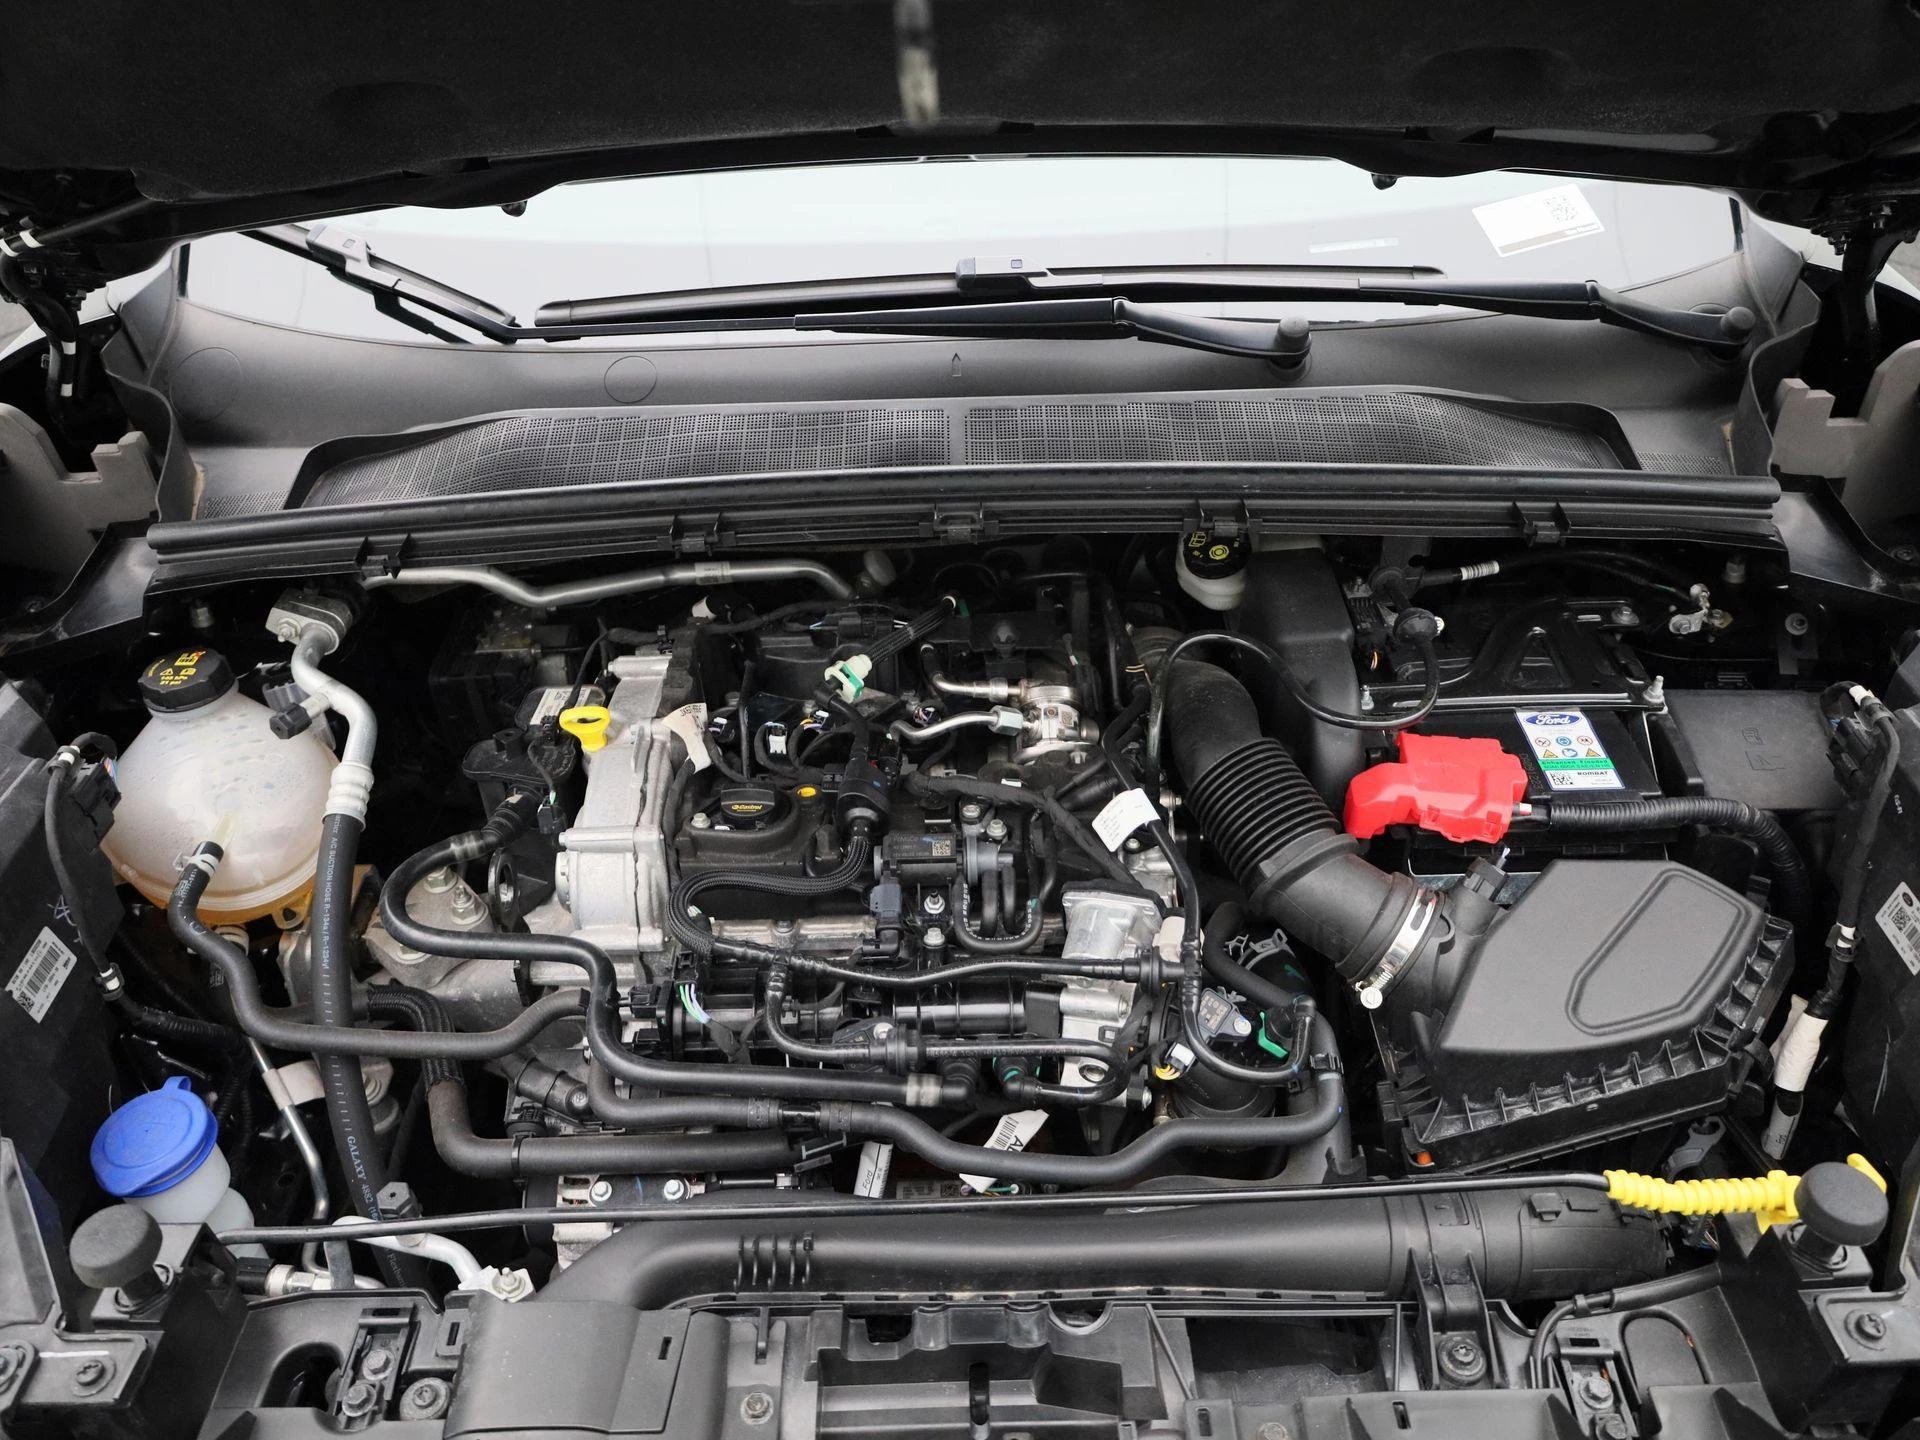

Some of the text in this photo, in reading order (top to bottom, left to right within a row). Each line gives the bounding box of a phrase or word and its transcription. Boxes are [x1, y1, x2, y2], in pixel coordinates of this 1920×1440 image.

[1535, 713, 1571, 725] Ford
[326, 850, 336, 881] SUCTION
[324, 882, 332, 902] HOSE
[347, 1135, 367, 1179] GALAXY
[361, 1183, 374, 1204] 4882
[862, 1170, 873, 1189] Ford
